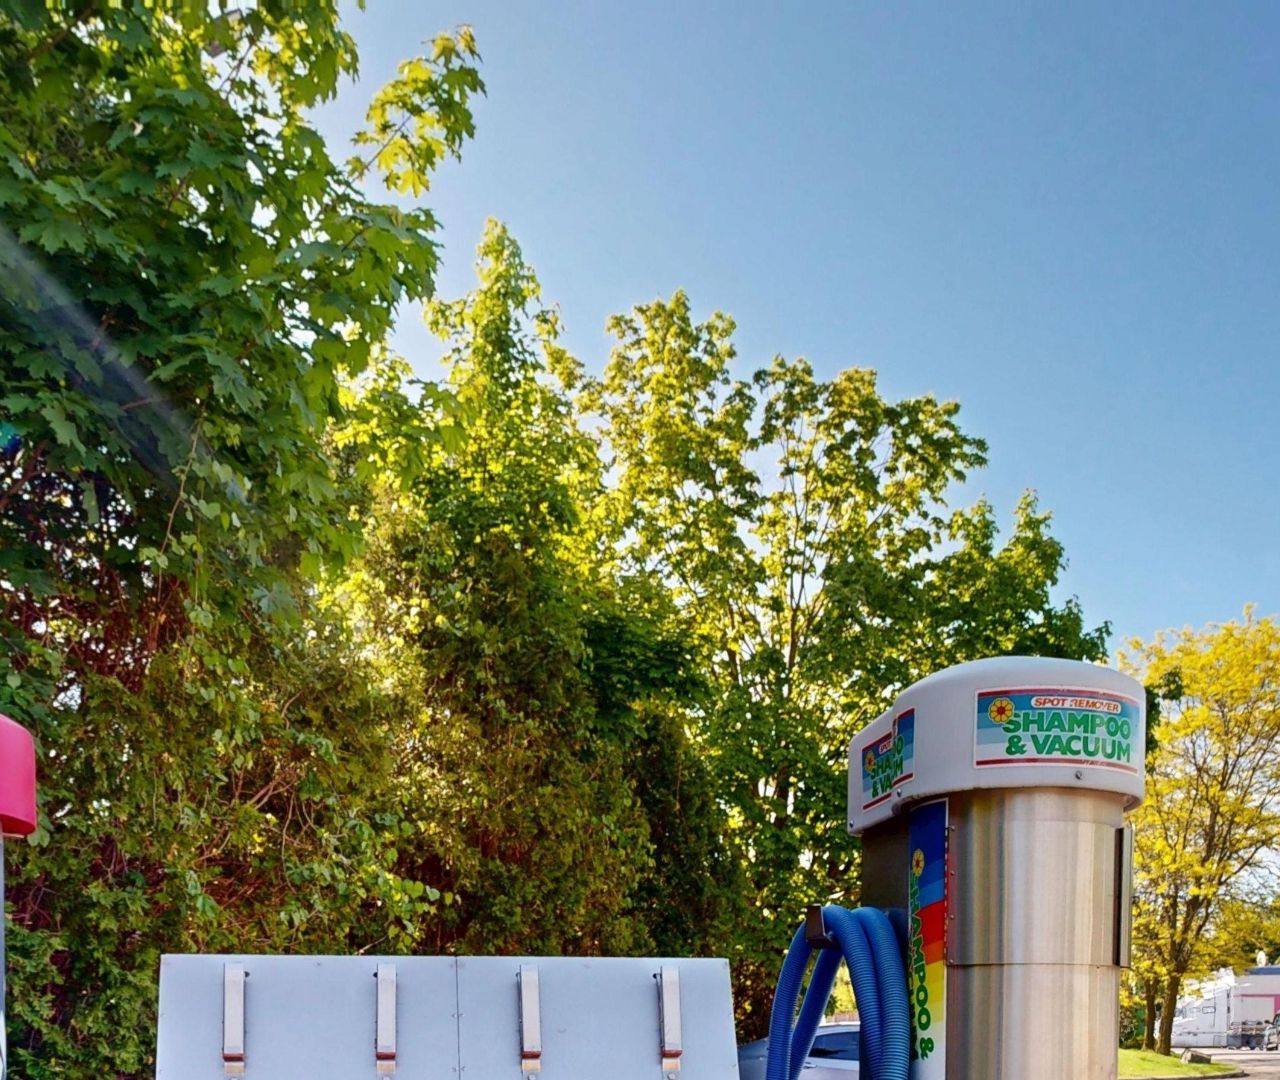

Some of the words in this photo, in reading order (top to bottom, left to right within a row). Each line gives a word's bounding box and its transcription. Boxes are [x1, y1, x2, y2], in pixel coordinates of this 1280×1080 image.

[1035, 697, 1067, 707] SPOT
[1002, 711, 1131, 740] SHAMPOO
[1005, 735, 1027, 755] &
[1030, 734, 1131, 763] VACUUM
